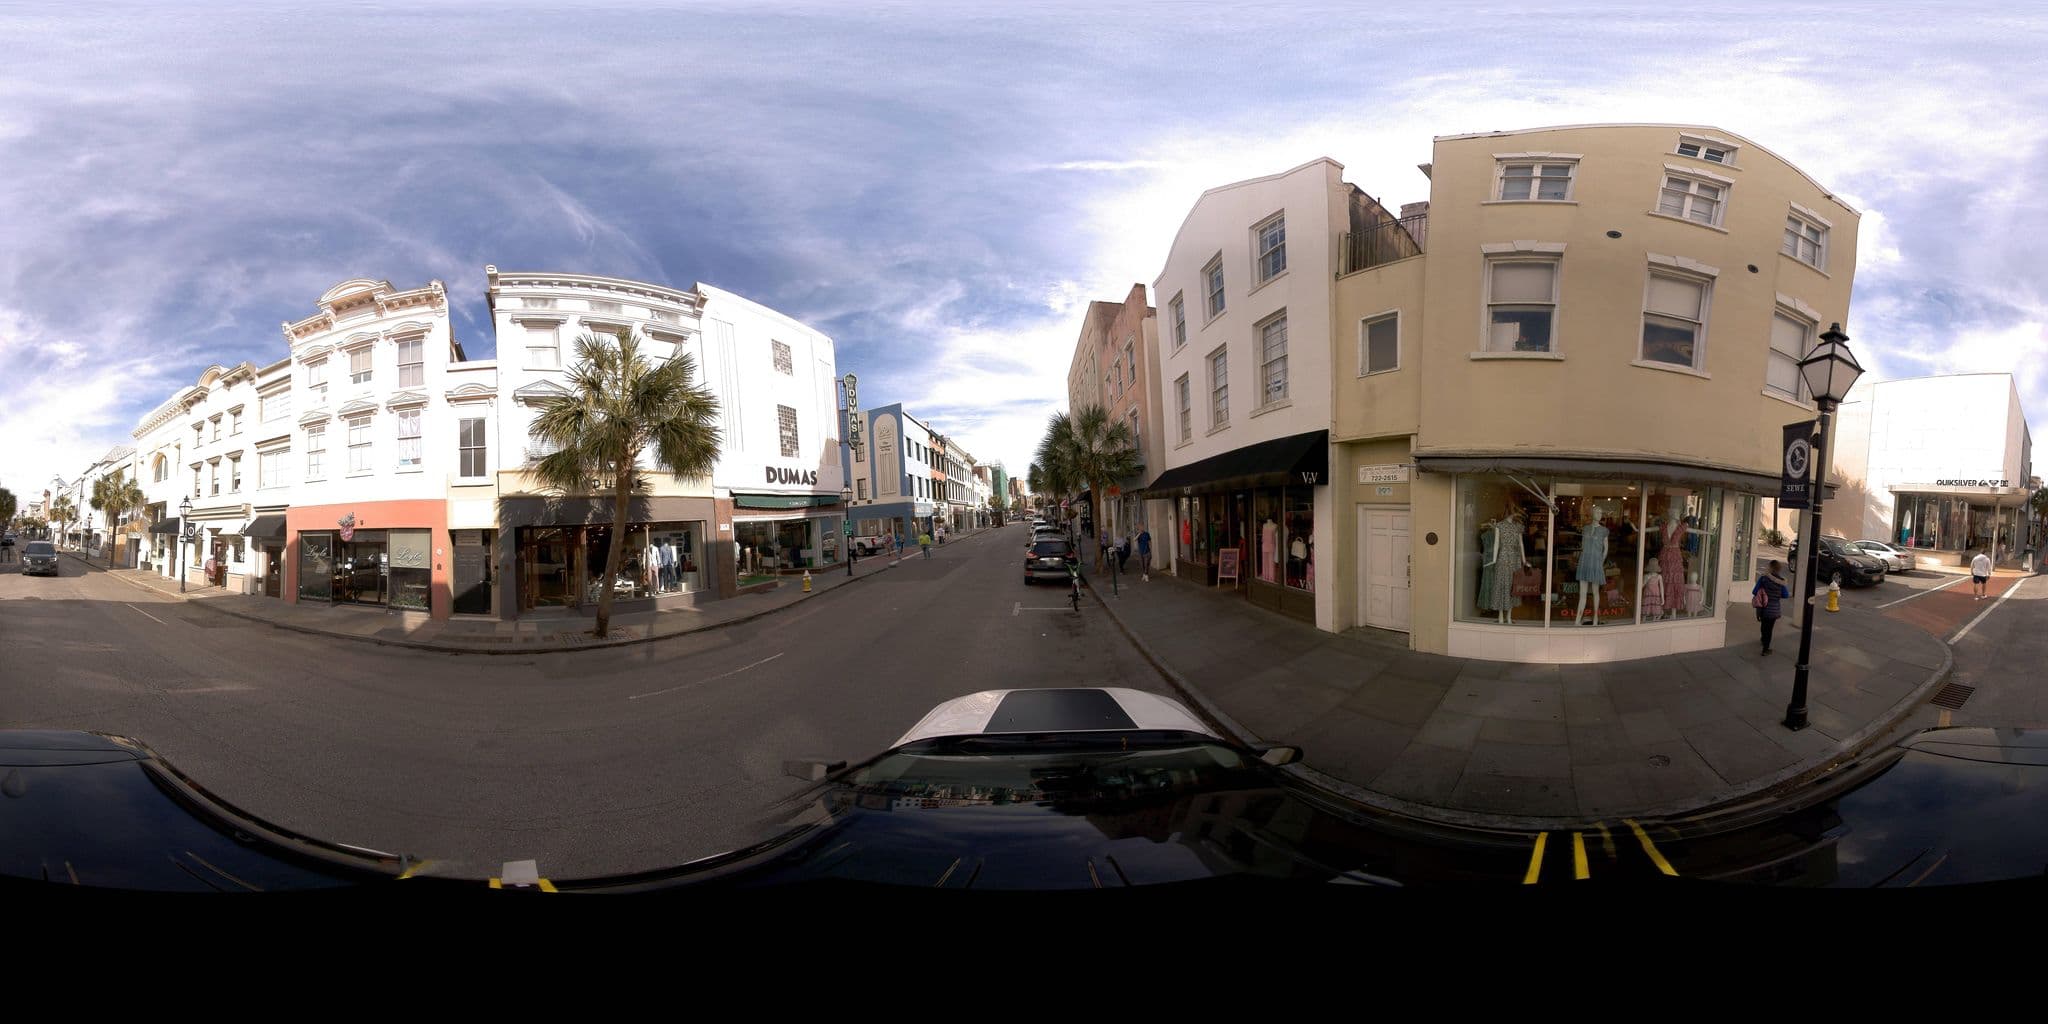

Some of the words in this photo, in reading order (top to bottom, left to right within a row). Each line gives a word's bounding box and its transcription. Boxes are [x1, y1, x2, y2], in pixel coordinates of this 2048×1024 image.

[849, 389, 858, 433] DUMAS
[766, 466, 818, 486] DUMAS
[1936, 479, 1977, 487] QUIKSILVER
